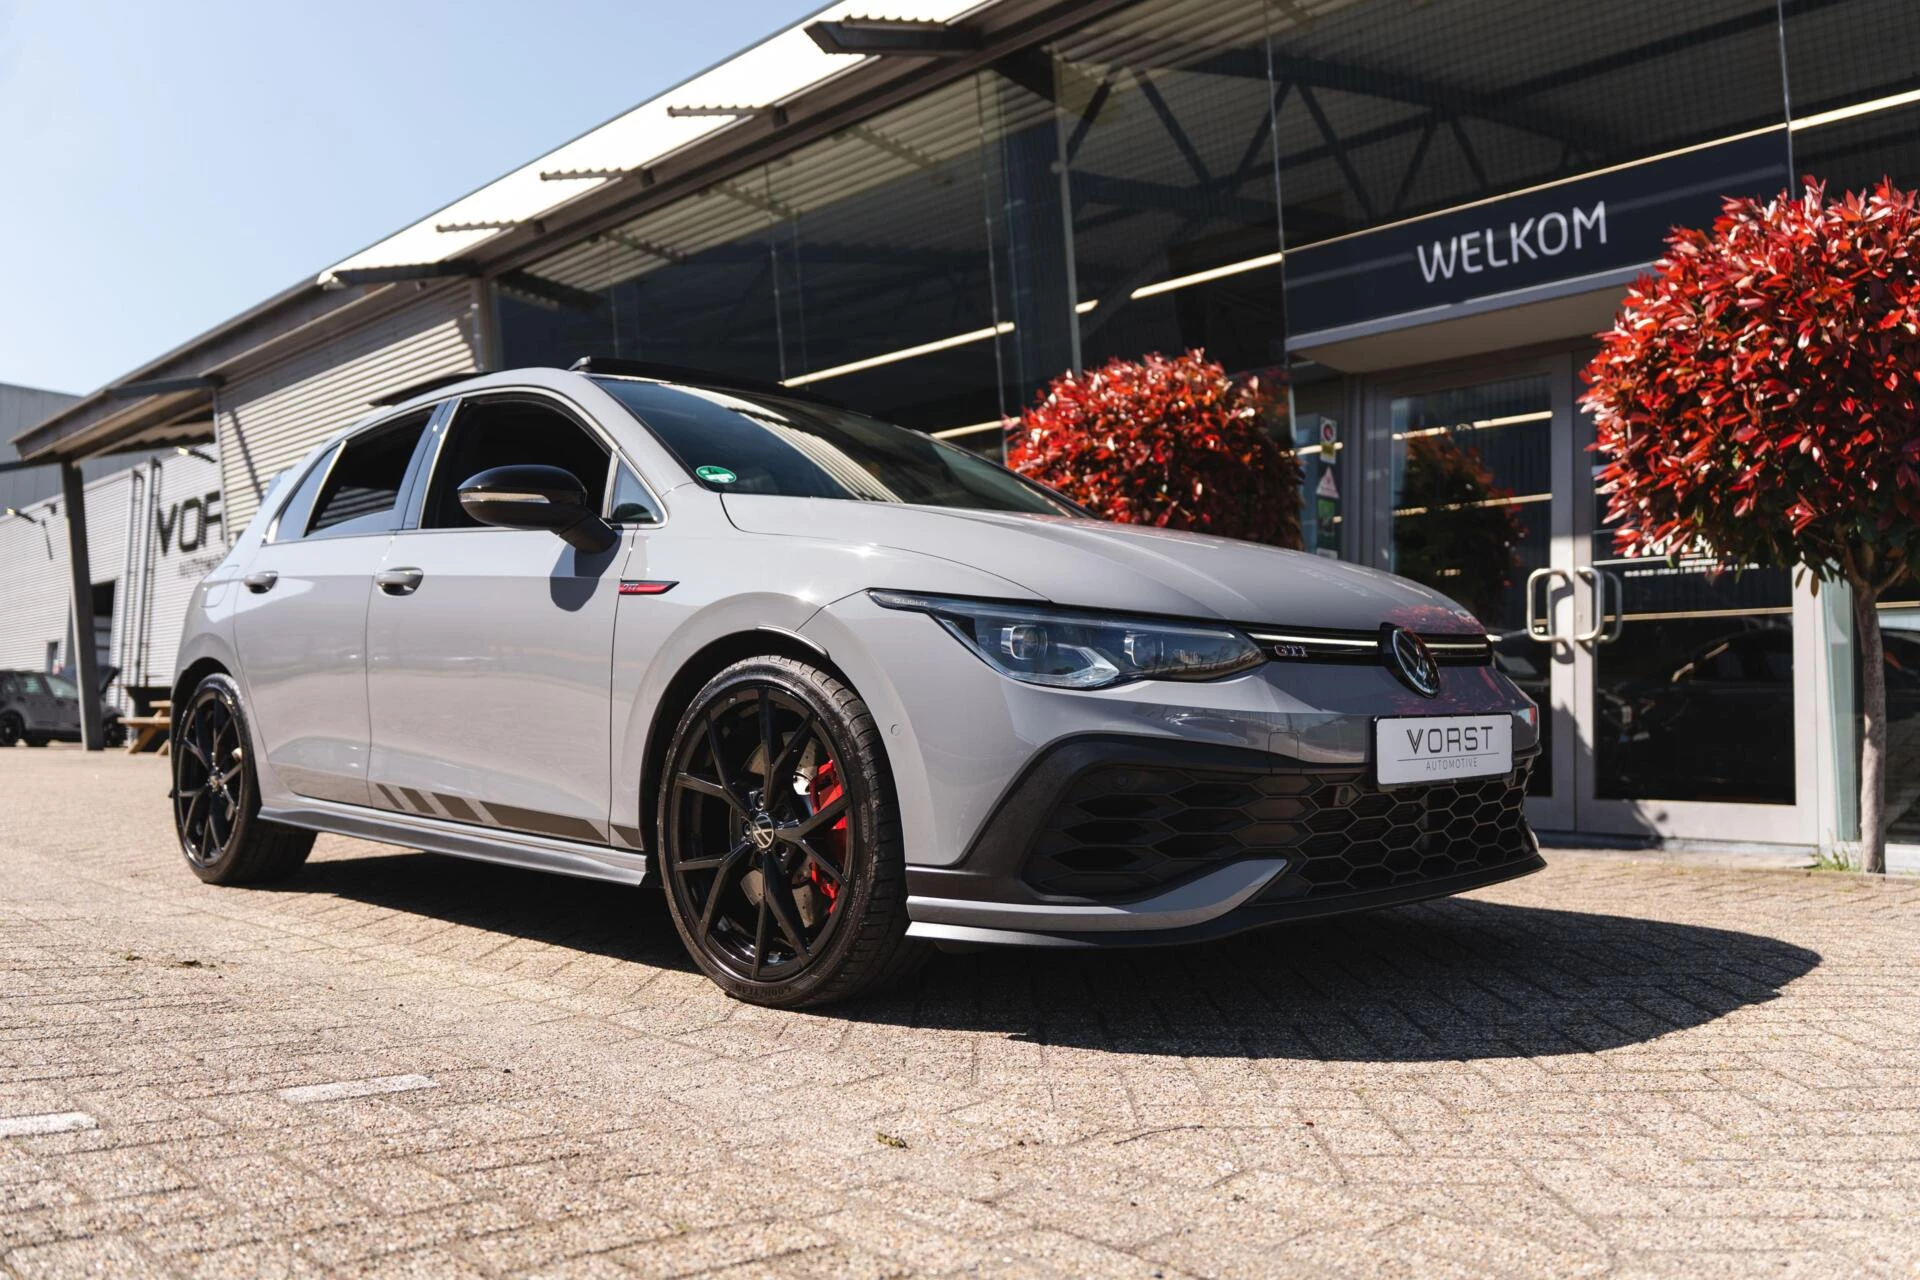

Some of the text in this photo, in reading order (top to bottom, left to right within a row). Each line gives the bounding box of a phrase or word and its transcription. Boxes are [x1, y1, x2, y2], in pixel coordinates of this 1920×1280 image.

[1417, 200, 1607, 283] WELKOM
[1274, 644, 1308, 657] GTI
[1406, 726, 1493, 755] VORST
[1426, 758, 1478, 771] AUTOMOTIVE
